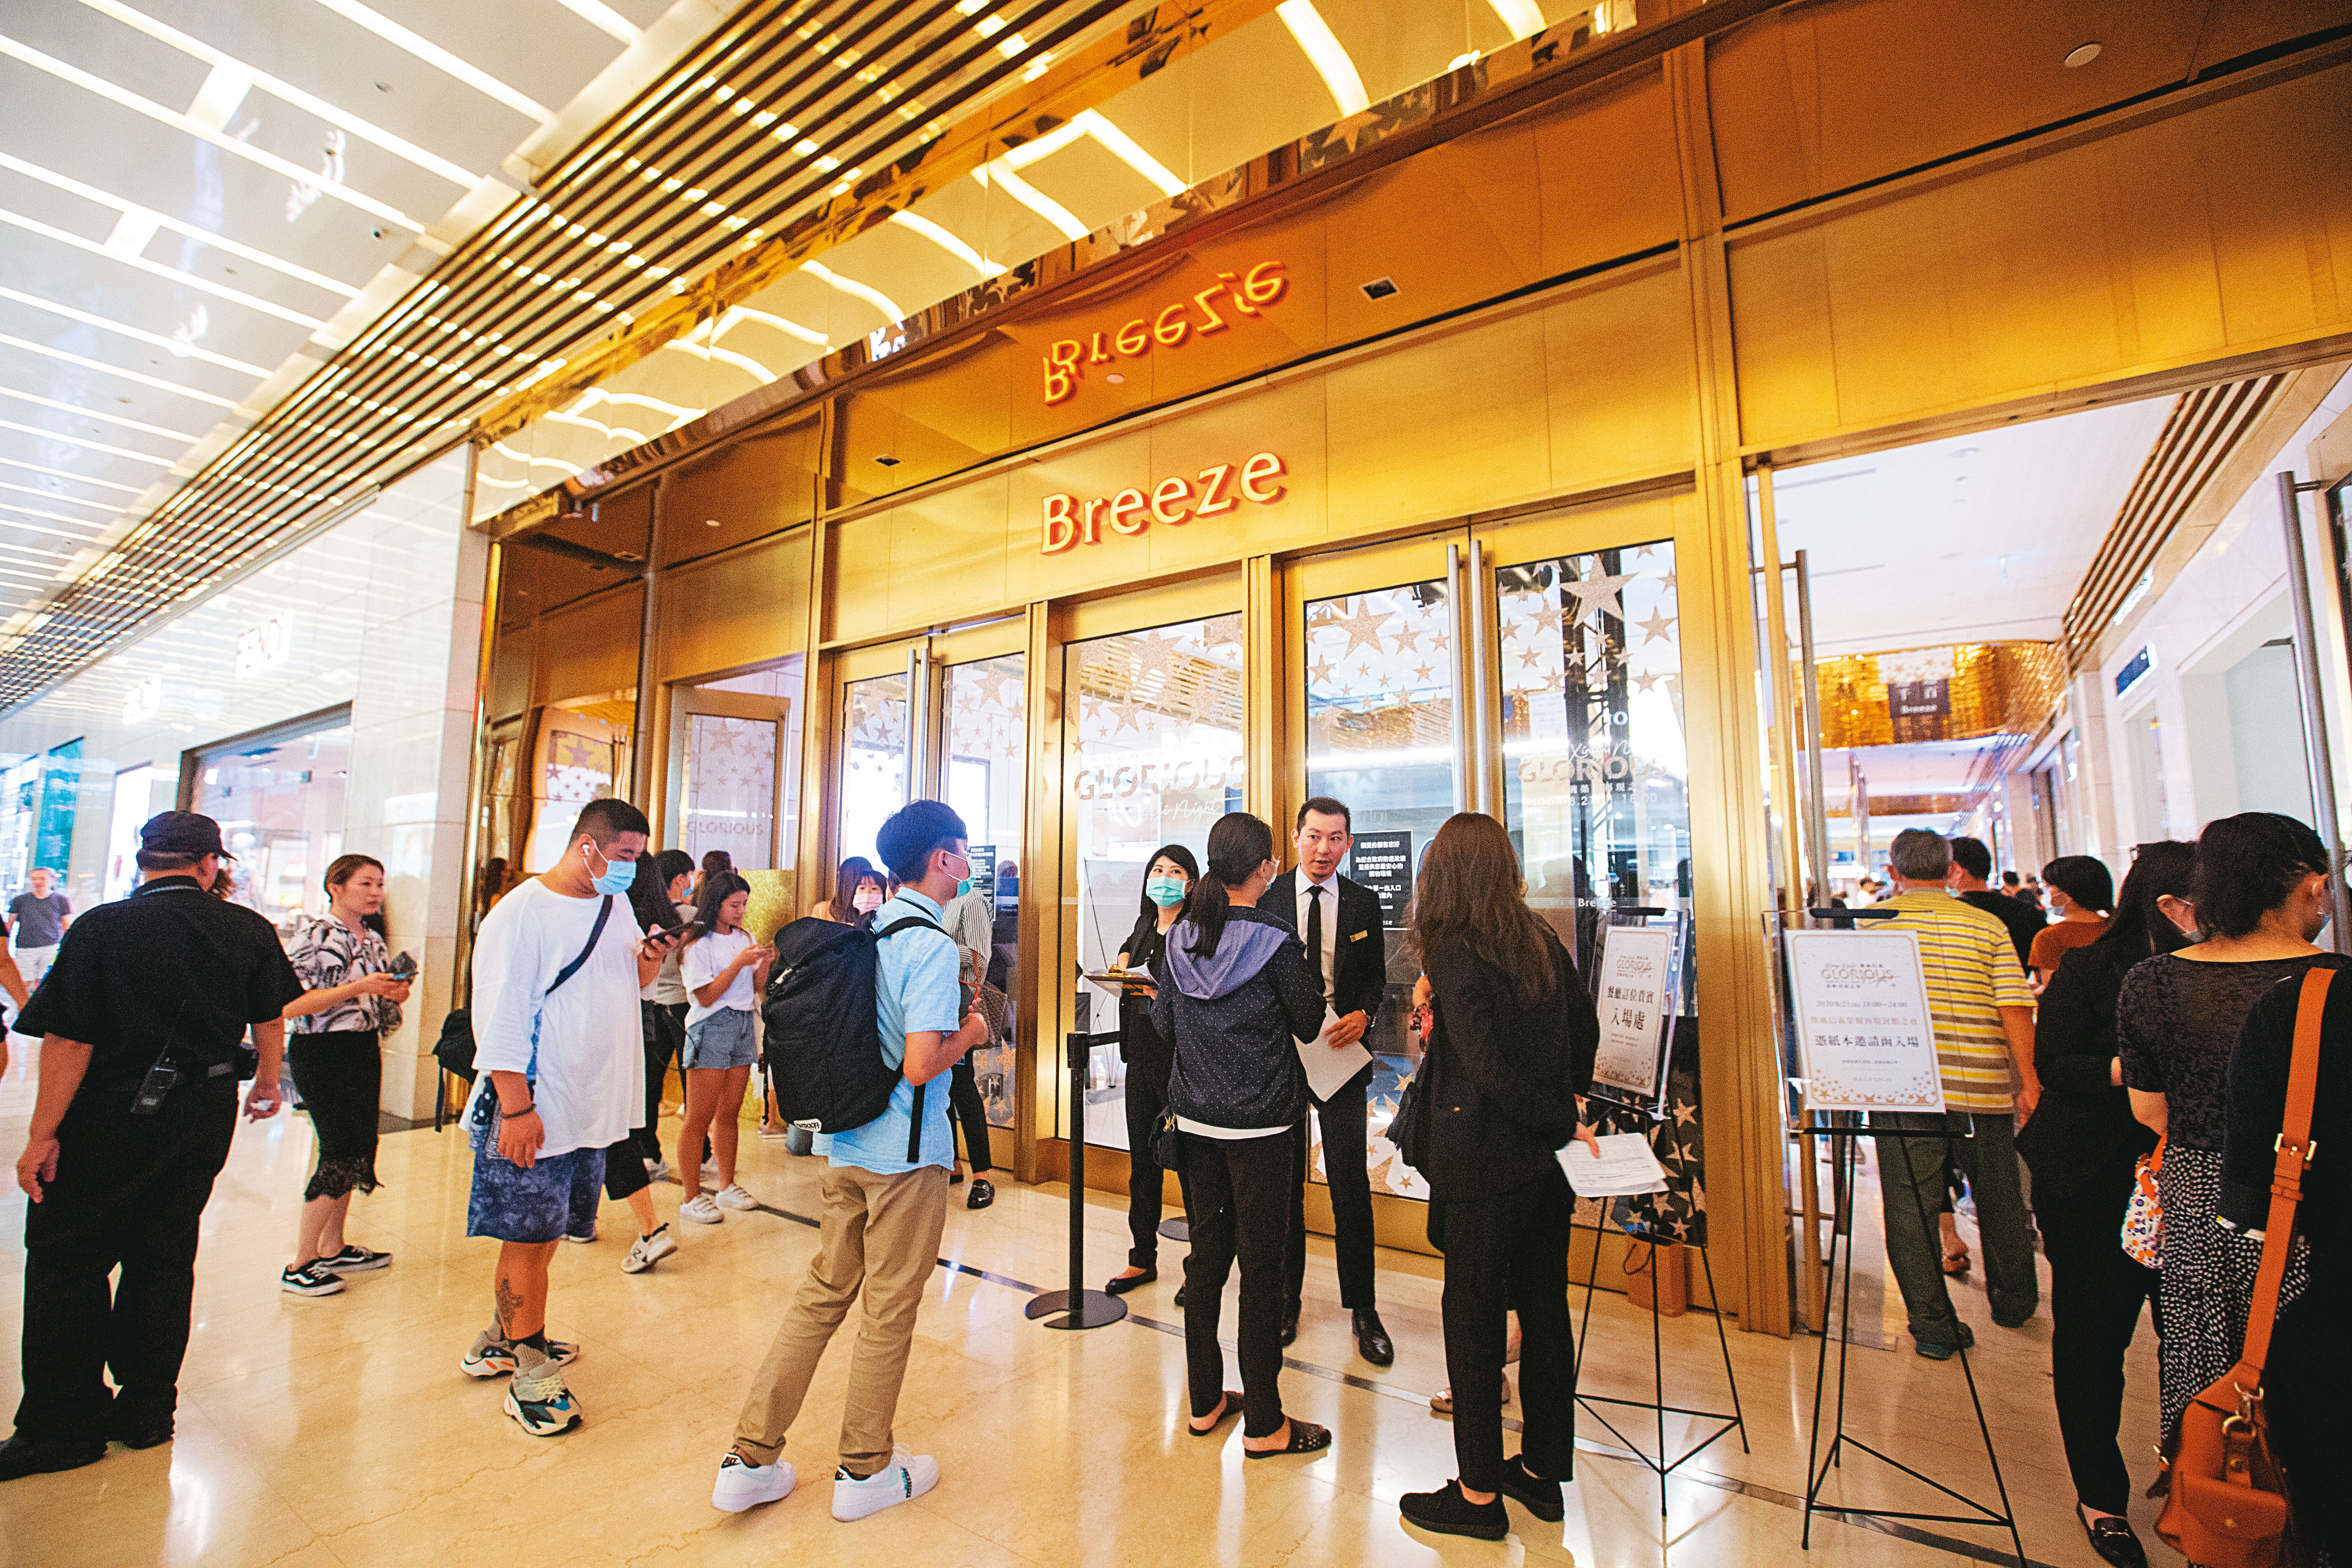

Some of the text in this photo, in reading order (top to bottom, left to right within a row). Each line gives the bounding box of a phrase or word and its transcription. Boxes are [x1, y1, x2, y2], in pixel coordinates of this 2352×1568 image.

[1040, 451, 1288, 555] Breeze
[687, 821, 763, 835] GLORIOUS
[1578, 898, 1617, 907] Breze
[1821, 969, 1893, 979] GLORIOUS
[1611, 1008, 1645, 1029] 入場處
[1815, 1035, 1919, 1047] 憑紙本邀請函入場
